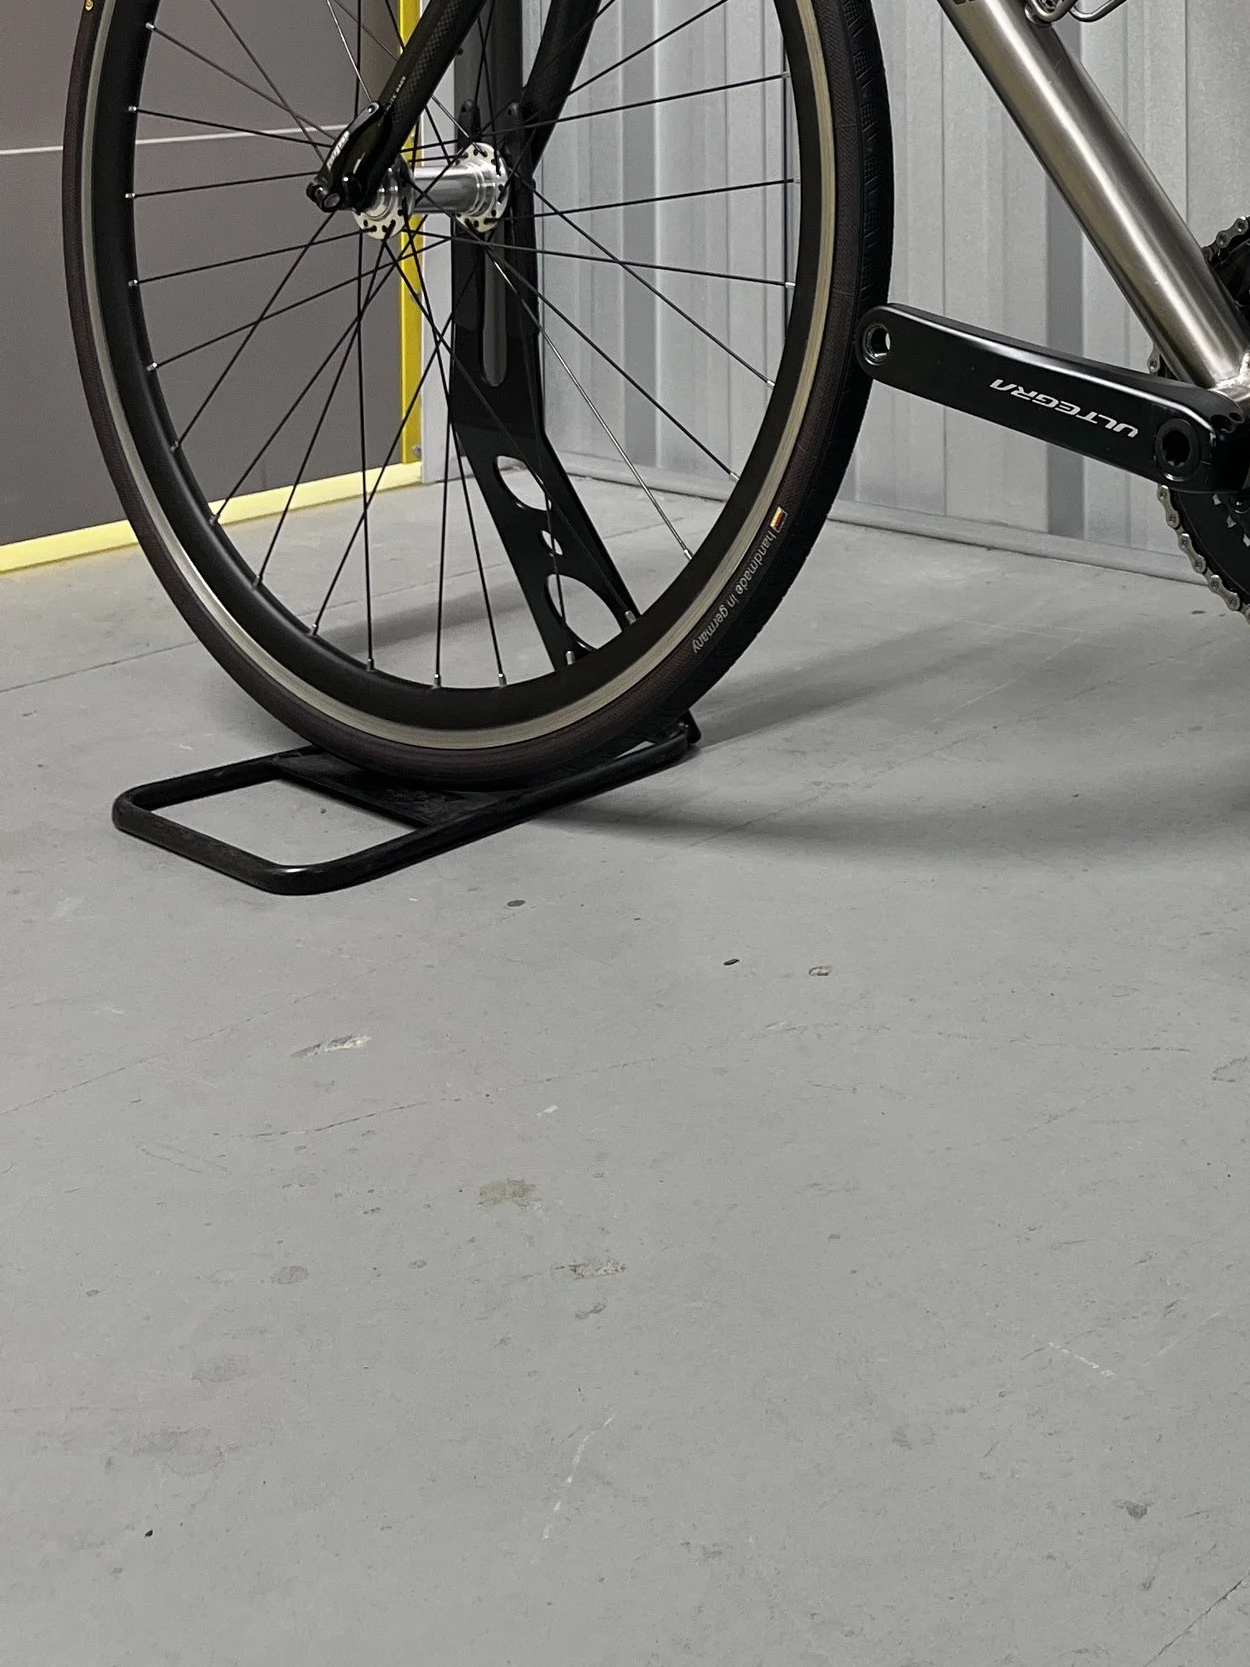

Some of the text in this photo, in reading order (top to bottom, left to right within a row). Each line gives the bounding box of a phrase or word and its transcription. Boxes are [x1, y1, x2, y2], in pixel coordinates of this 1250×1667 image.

[989, 378, 1139, 439] ULTEGRA
[691, 529, 777, 654] handmade in germany
